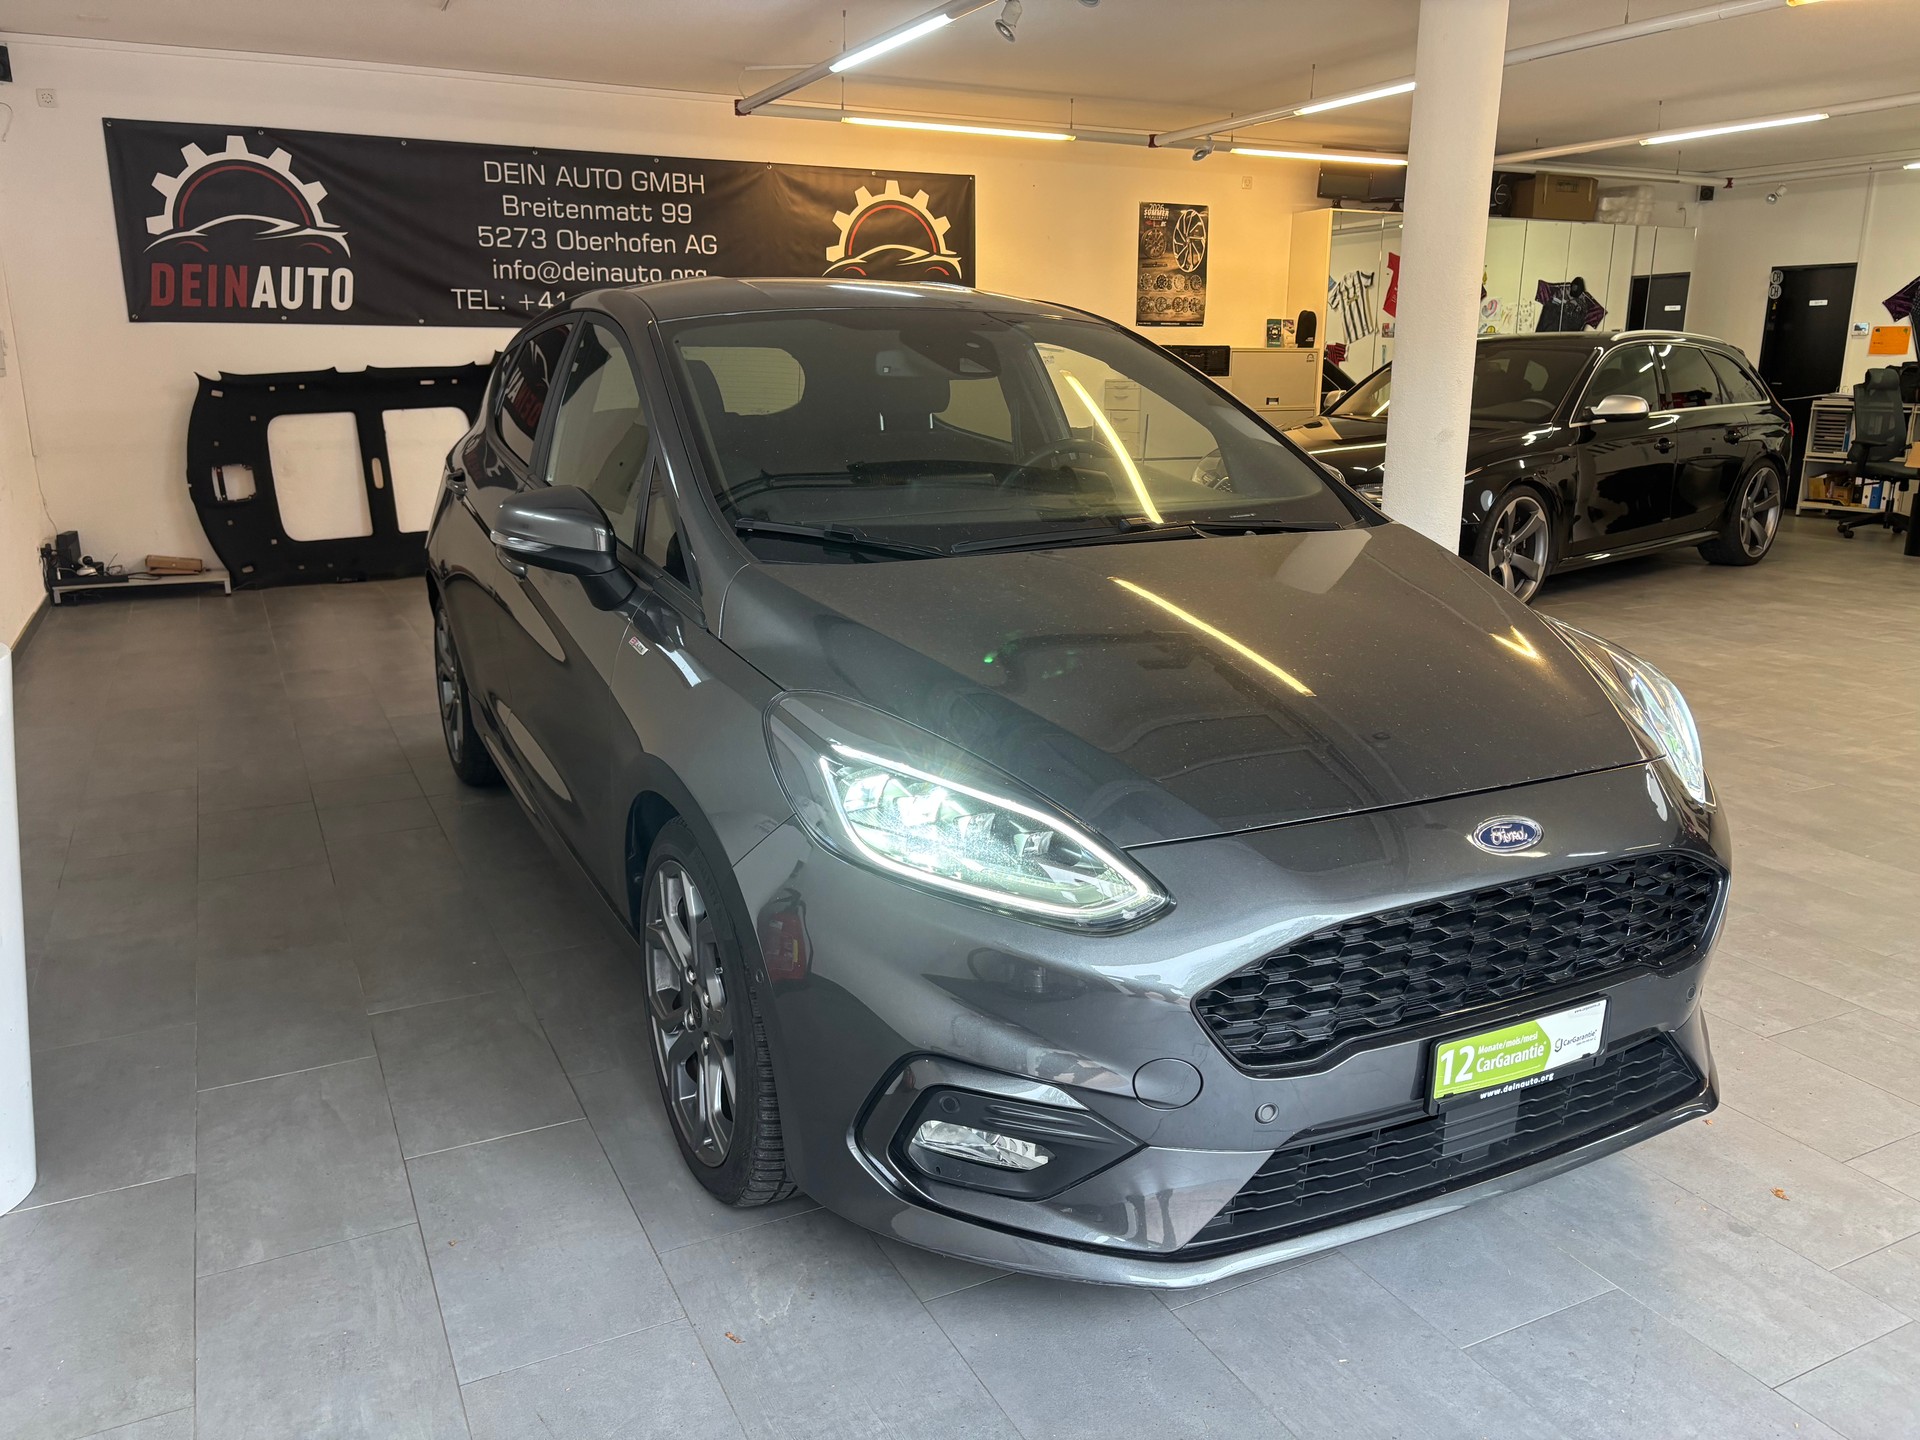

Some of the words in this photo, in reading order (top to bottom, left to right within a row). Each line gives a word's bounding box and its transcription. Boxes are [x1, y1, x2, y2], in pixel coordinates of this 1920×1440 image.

[483, 160, 546, 186] DEIN
[555, 165, 623, 190] AUTO
[631, 170, 706, 194] GMBH
[502, 194, 653, 222] Breitenmatt
[661, 202, 693, 224] 99
[477, 225, 548, 249] 5273
[556, 229, 677, 253] Oberhofen
[684, 234, 718, 255] AG
[450, 288, 506, 311] TEL:
[1490, 823, 1528, 846] Ford
[1440, 1045, 1476, 1086] 12
[1479, 1072, 1555, 1100] www.deinauto.org
